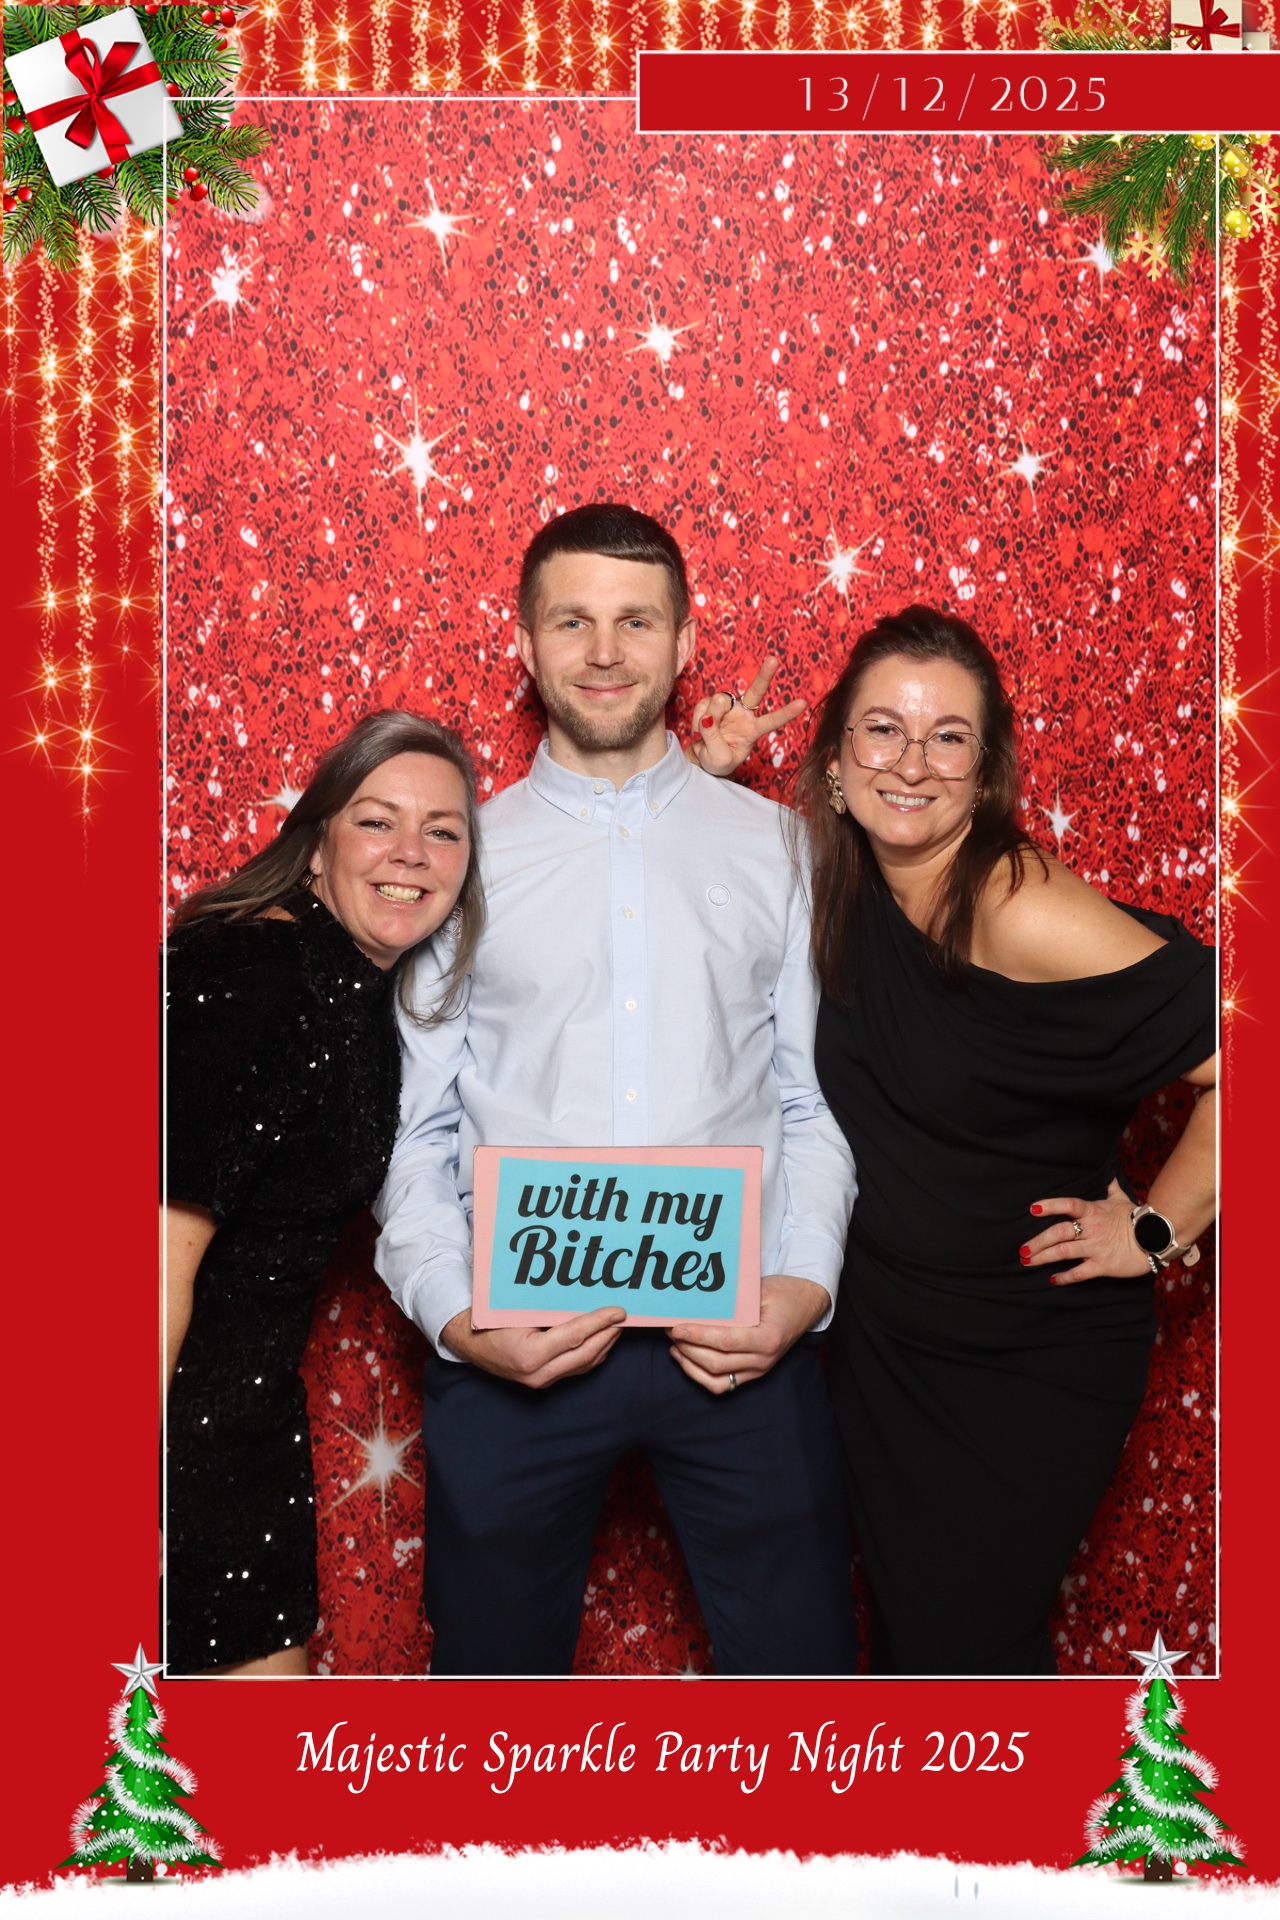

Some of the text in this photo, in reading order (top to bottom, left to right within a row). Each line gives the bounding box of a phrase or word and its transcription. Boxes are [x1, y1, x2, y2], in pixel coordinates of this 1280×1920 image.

[517, 1173, 724, 1242] with my
[508, 1224, 726, 1292] Bitches
